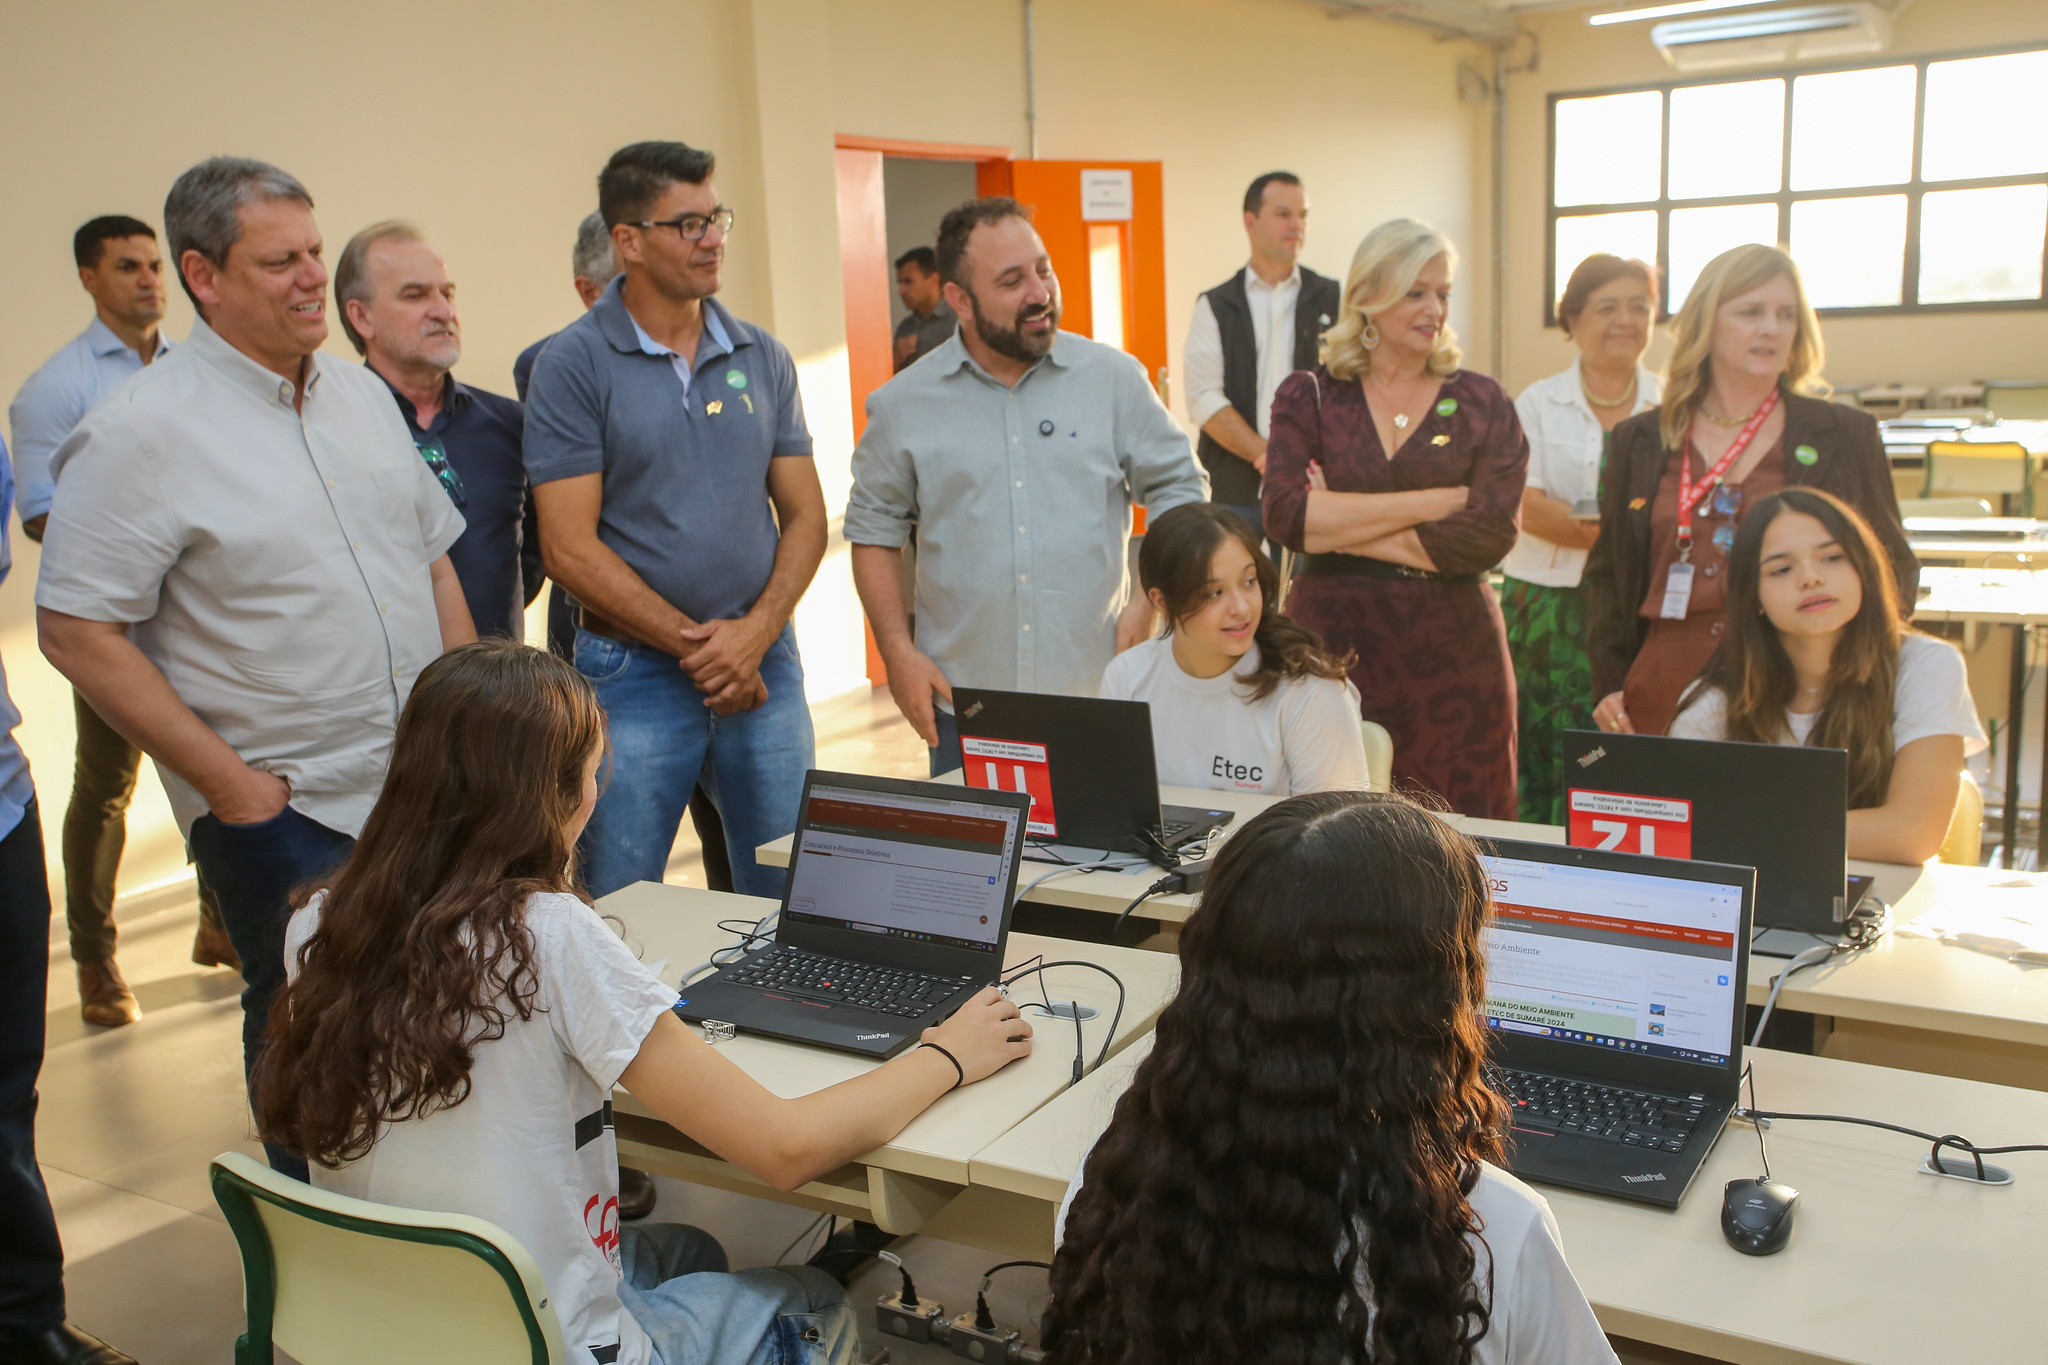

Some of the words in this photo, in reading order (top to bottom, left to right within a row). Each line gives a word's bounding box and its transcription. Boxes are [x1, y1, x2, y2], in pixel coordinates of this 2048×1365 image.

[1212, 755, 1263, 782] Etec
[804, 841, 832, 850] Concursos
[838, 845, 864, 854] Processos
[866, 849, 891, 858] Seletivos
[1531, 911, 1559, 920] Departamentos
[1487, 942, 1500, 950] eio
[1501, 944, 1540, 956] Ambiente
[1486, 1000, 1506, 1008] MANA
[1508, 1002, 1519, 1010] DO
[1520, 1004, 1538, 1013] MEIO
[1538, 1008, 1575, 1019] AMBIENTE
[1516, 1012, 1546, 1024] SUMARÉ
[1547, 1018, 1565, 1027] 2024
[856, 1032, 890, 1041] ThinkPad
[1620, 1172, 1666, 1184] ThinkPad
